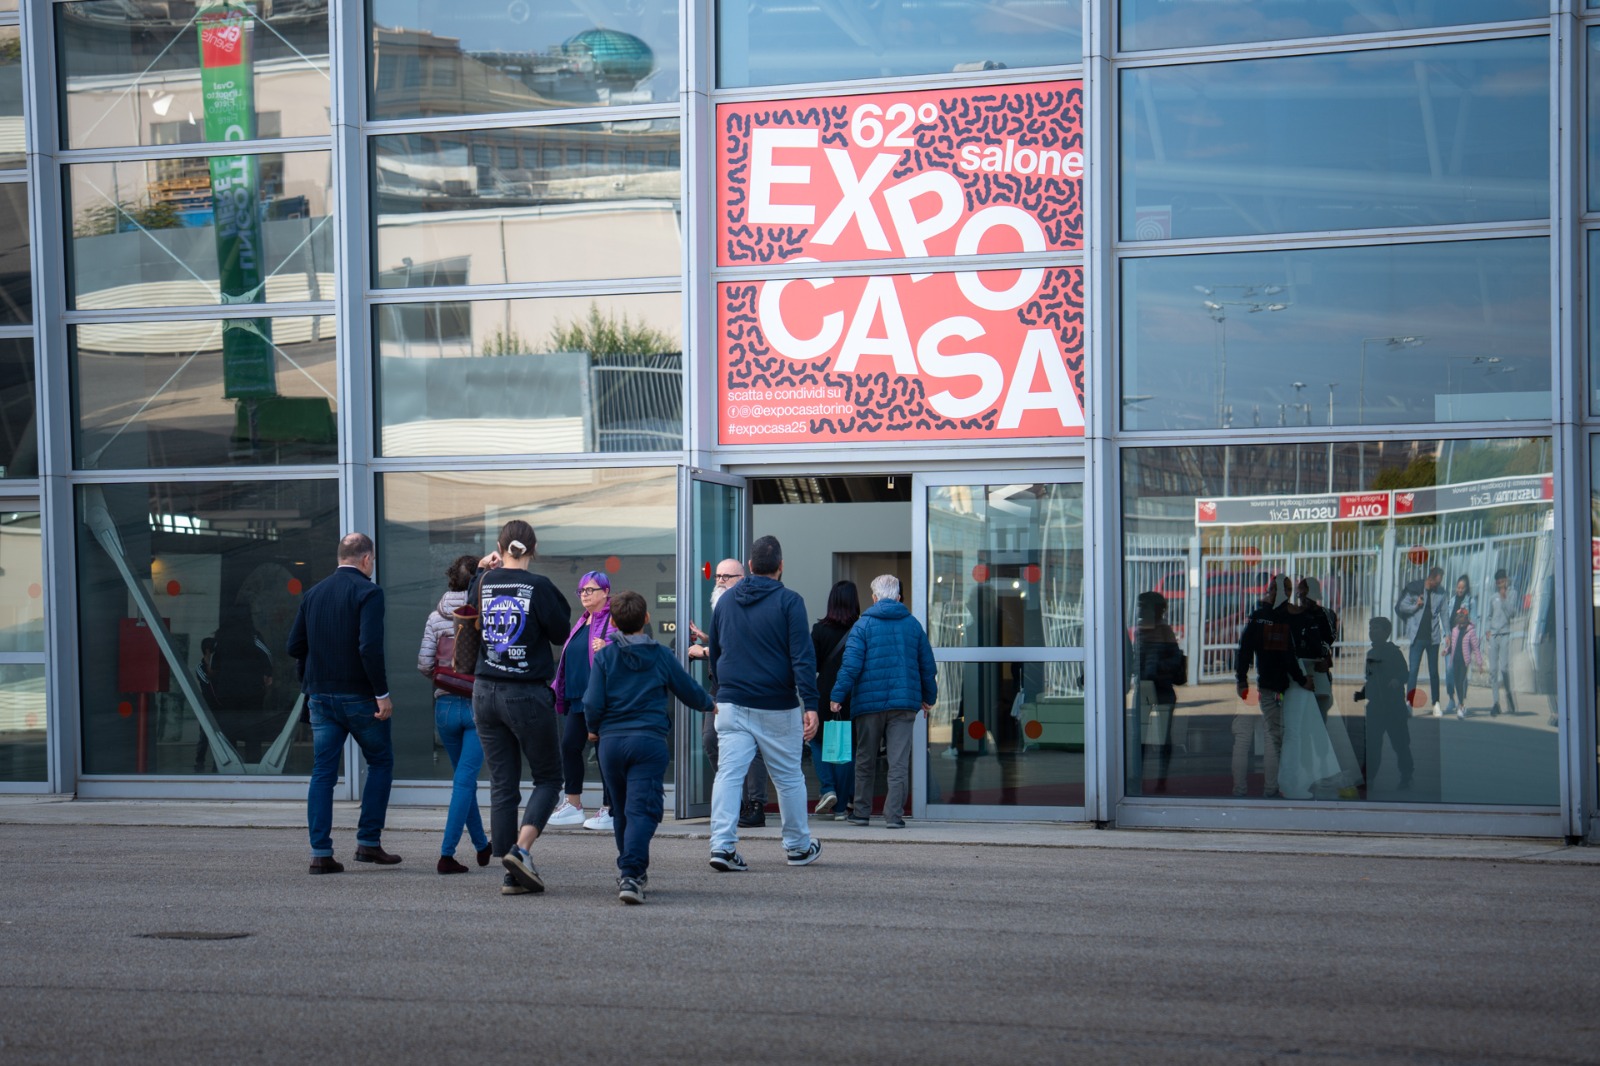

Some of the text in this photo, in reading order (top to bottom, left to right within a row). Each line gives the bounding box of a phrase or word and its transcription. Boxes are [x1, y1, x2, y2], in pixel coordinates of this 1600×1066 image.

[960, 139, 1084, 178] salone
[748, 127, 1047, 312] EXPO
[758, 257, 1086, 430] CASA
[728, 387, 841, 401] scatta e condividi su
[751, 403, 854, 418] @expocasatorino
[728, 421, 807, 436] #expocasa25
